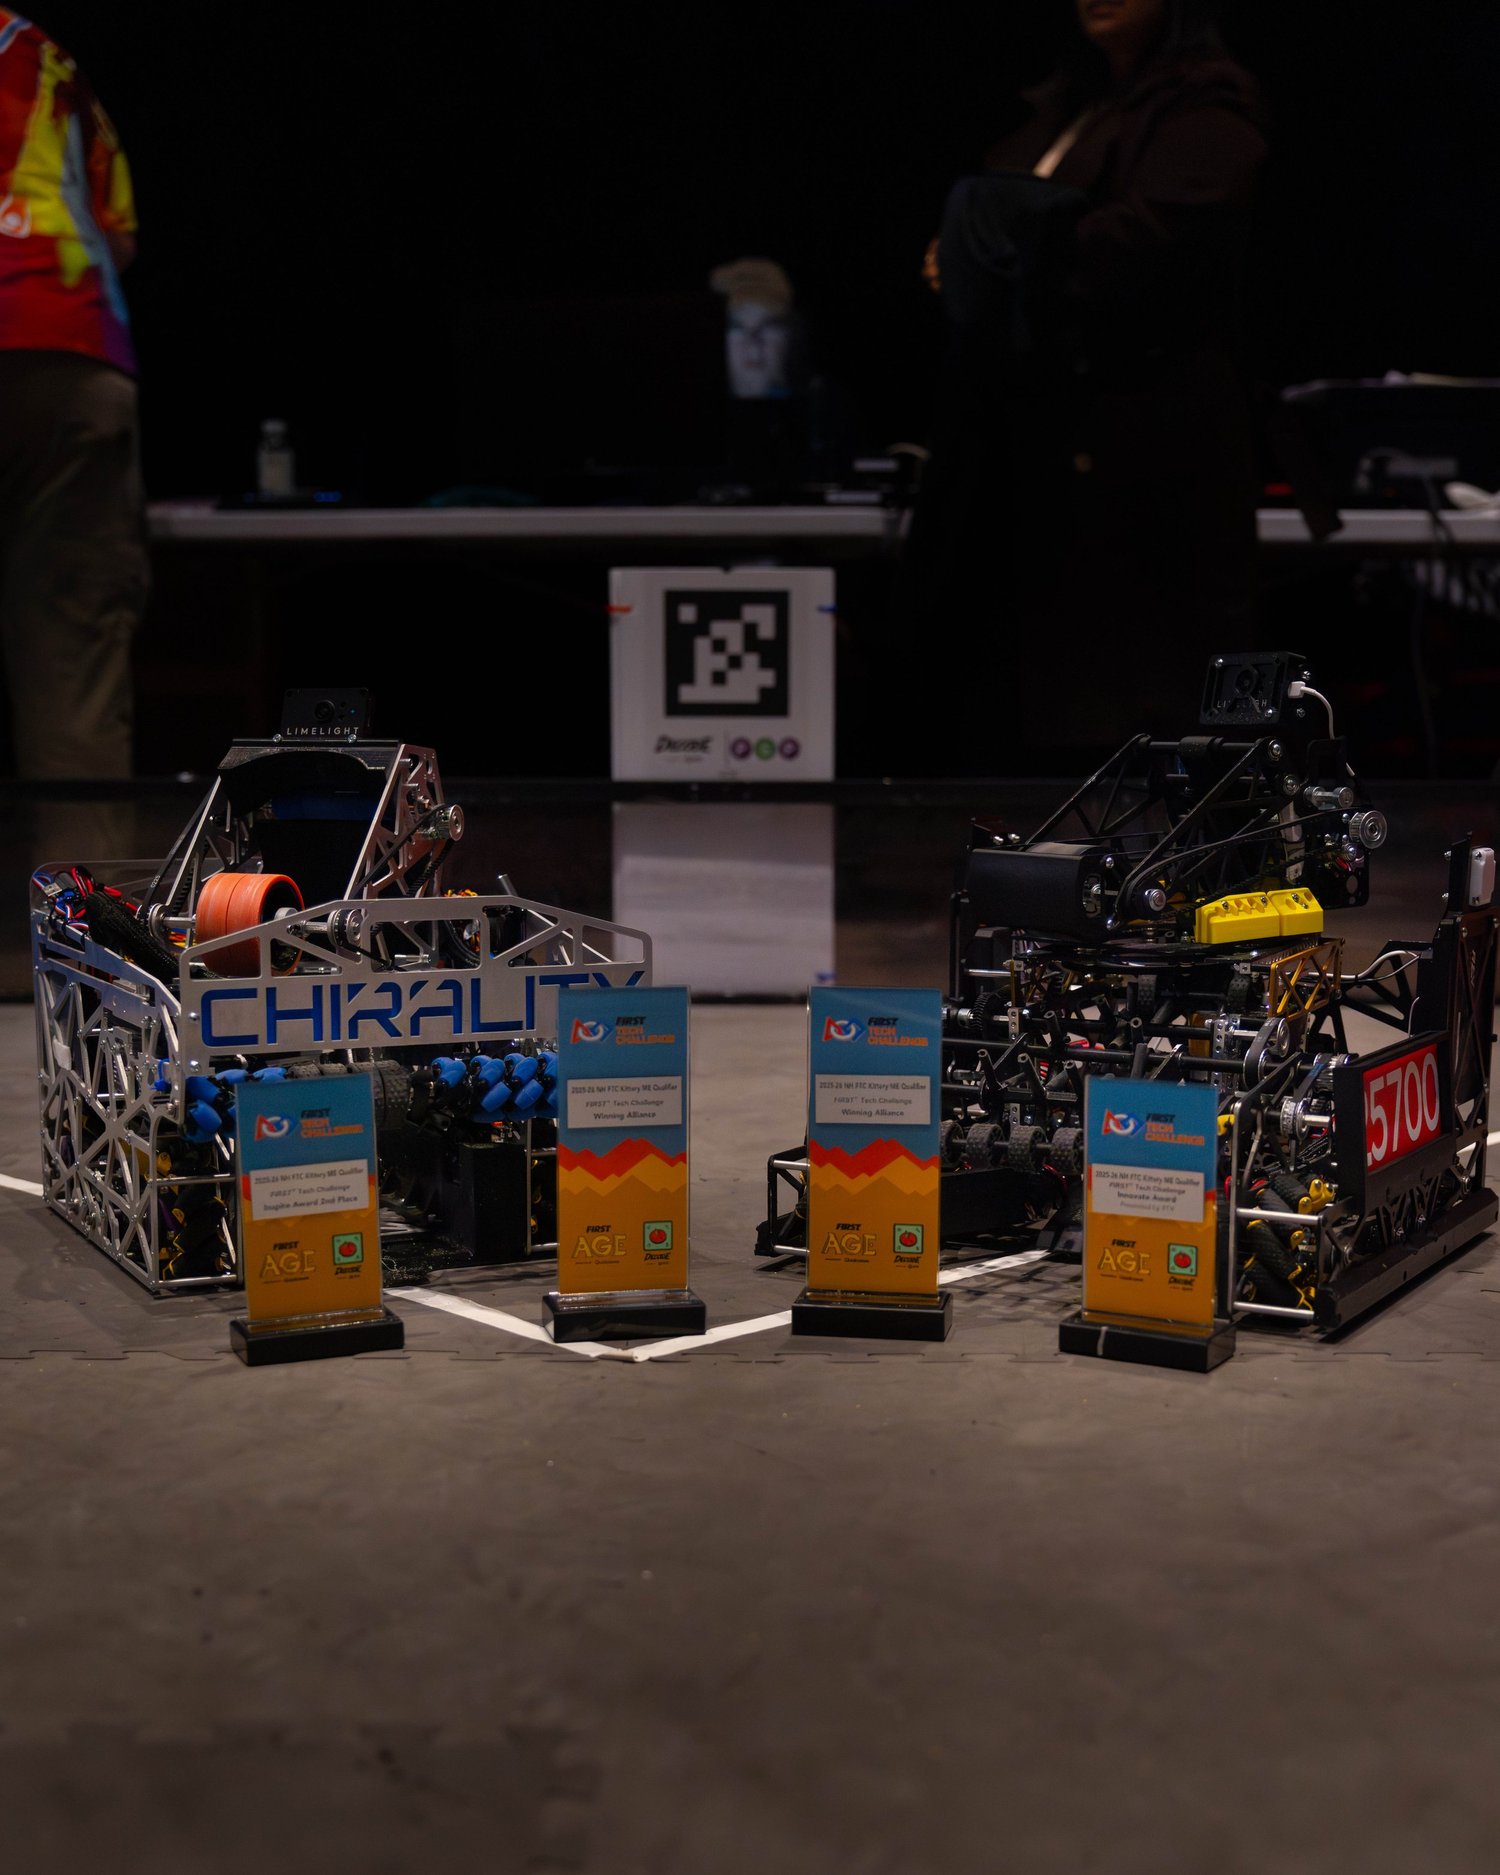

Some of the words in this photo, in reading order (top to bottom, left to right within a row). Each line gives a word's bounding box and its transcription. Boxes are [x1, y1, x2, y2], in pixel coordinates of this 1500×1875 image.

[286, 727, 359, 736] LIMELIGHT
[616, 1016, 646, 1026] FIRST
[868, 1016, 899, 1026] FIRST
[842, 1108, 872, 1118] Winning
[1364, 1052, 1440, 1166] 5700
[594, 1112, 625, 1120] Winning
[626, 1111, 656, 1119] Alliance
[292, 1199, 318, 1208] Award
[320, 1196, 336, 1205] 2nd
[1118, 1192, 1150, 1200] Innovate
[1152, 1195, 1176, 1204] Award
[586, 1225, 611, 1233] FIRST
[272, 1241, 299, 1250] FIRST
[571, 1234, 627, 1258] AGE
[821, 1232, 877, 1256] AGE
[1112, 1239, 1136, 1248] FIRST
[260, 1250, 316, 1277] AGE
[1098, 1248, 1152, 1276] AGE
